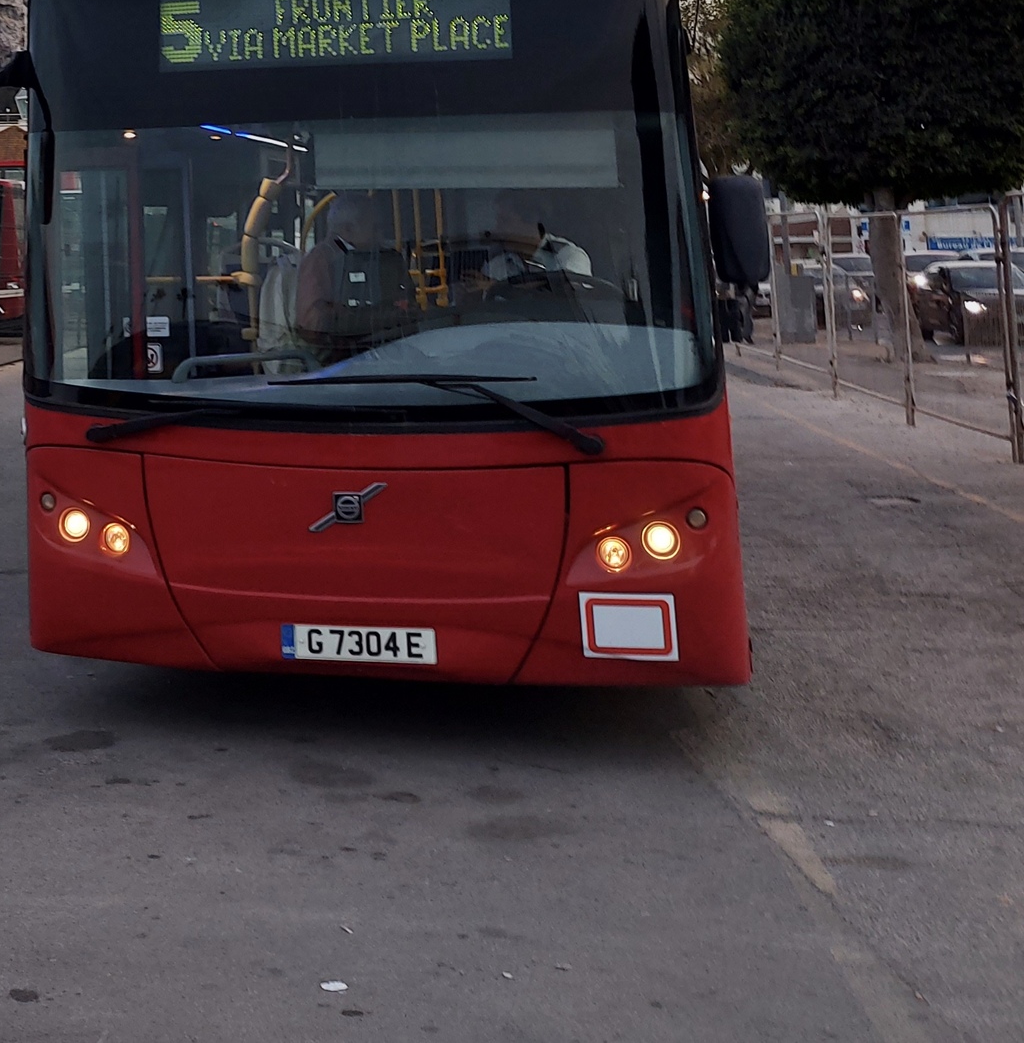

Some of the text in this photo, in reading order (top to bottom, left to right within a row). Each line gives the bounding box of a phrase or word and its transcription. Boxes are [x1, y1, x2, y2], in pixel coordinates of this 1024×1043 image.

[160, 1, 204, 63] 5
[204, 14, 510, 62] VIA MARKET PLACE
